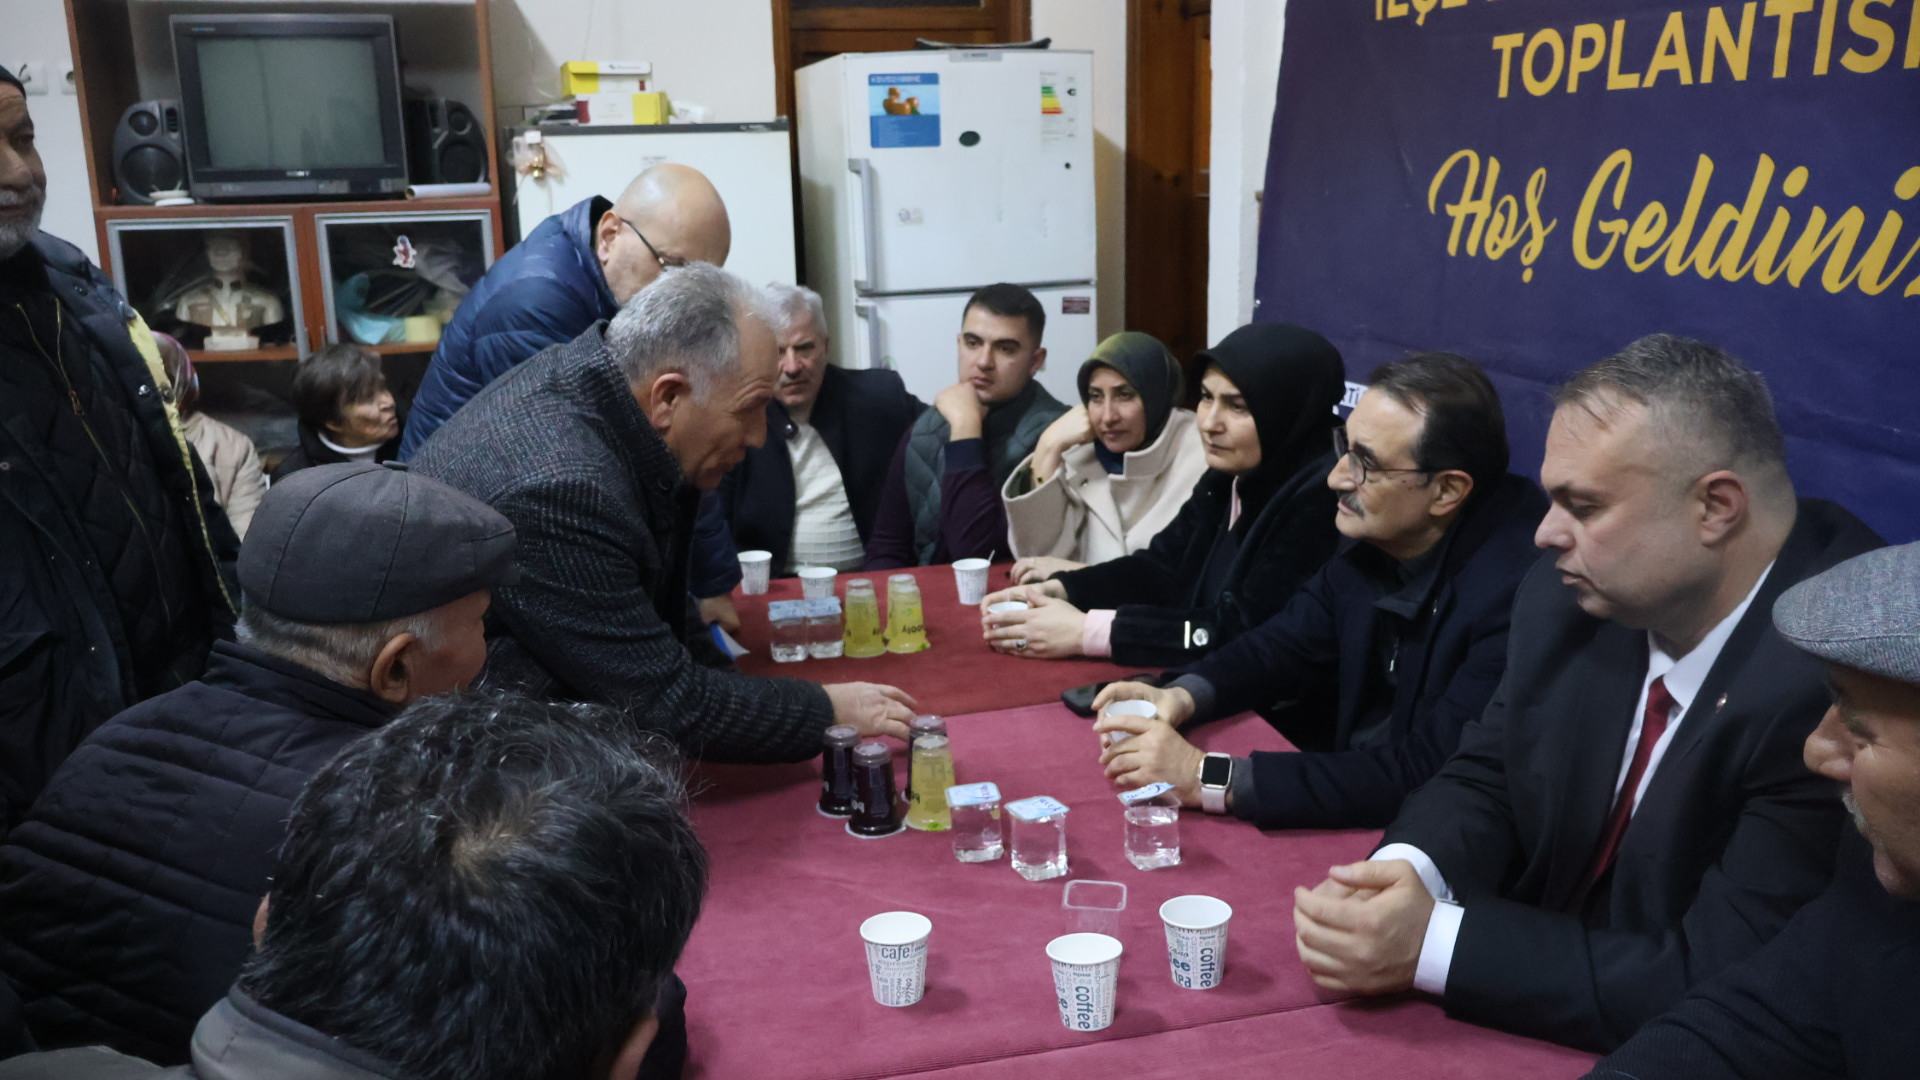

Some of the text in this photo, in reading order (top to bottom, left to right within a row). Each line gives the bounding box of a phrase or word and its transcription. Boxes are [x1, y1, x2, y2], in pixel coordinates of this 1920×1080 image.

[1492, 0, 1920, 98] TOPLANTISI
[1428, 149, 1556, 283] Hoş
[1199, 947, 1216, 988] coffee
[1074, 985, 1094, 1029] coffee
